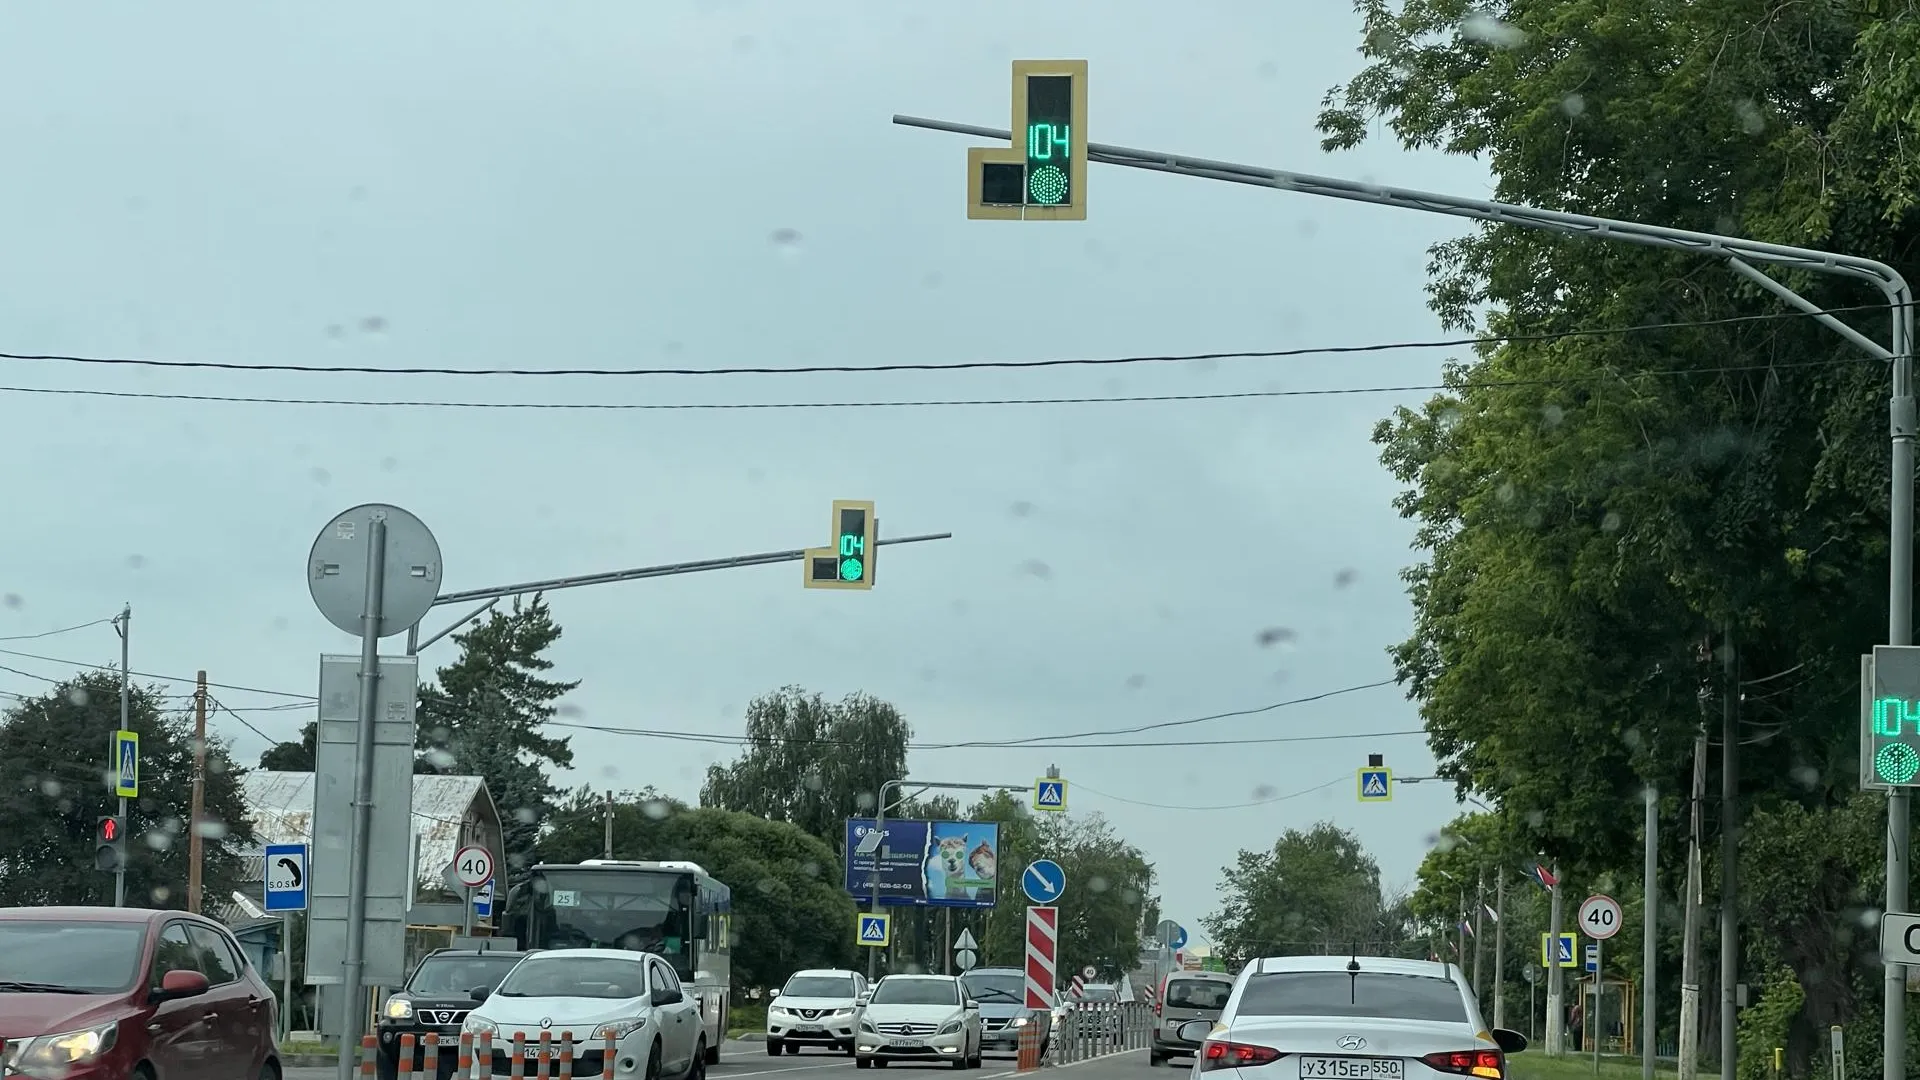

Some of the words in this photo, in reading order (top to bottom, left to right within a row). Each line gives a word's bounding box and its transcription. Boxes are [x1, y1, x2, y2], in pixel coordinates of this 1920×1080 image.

[1029, 123, 1070, 159] 104
[840, 534, 864, 556] 104
[1873, 697, 1920, 736] 104
[462, 859, 486, 876] 40
[558, 894, 570, 905] 25
[1588, 909, 1613, 925] 40
[1373, 1061, 1398, 1074] 550
